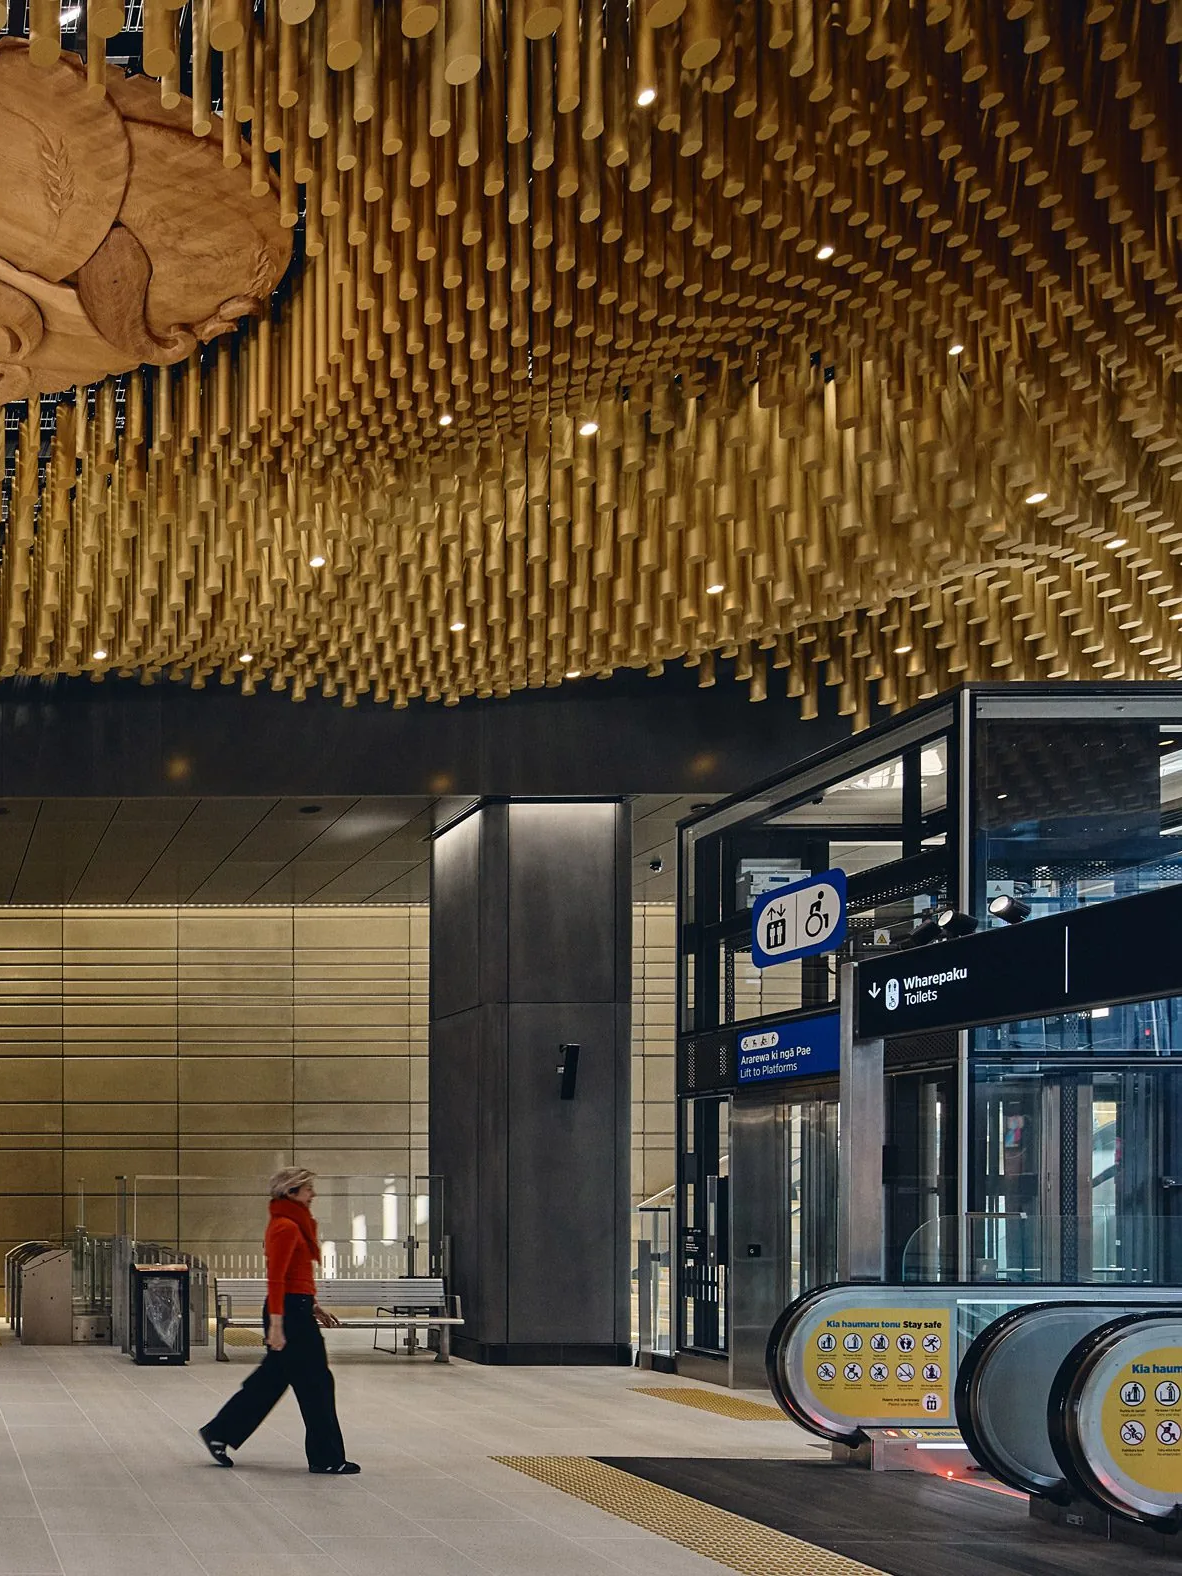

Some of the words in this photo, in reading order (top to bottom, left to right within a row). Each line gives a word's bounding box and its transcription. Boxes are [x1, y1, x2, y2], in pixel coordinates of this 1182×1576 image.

[903, 967, 968, 990] Wharepaku
[904, 989, 938, 1006] Toilets
[741, 1054, 770, 1065] Ararewa
[771, 1049, 778, 1060] ki
[779, 1048, 795, 1060] ngā
[796, 1046, 811, 1057] Pae
[740, 1067, 752, 1079] Lift
[753, 1067, 761, 1077] to
[762, 1062, 798, 1075] Platforms
[826, 1320, 840, 1328] Kia
[841, 1320, 880, 1328] haumaru
[881, 1320, 901, 1328] tonu
[902, 1320, 922, 1330] Stay
[923, 1320, 942, 1328] safe
[1132, 1364, 1150, 1374] Kia
